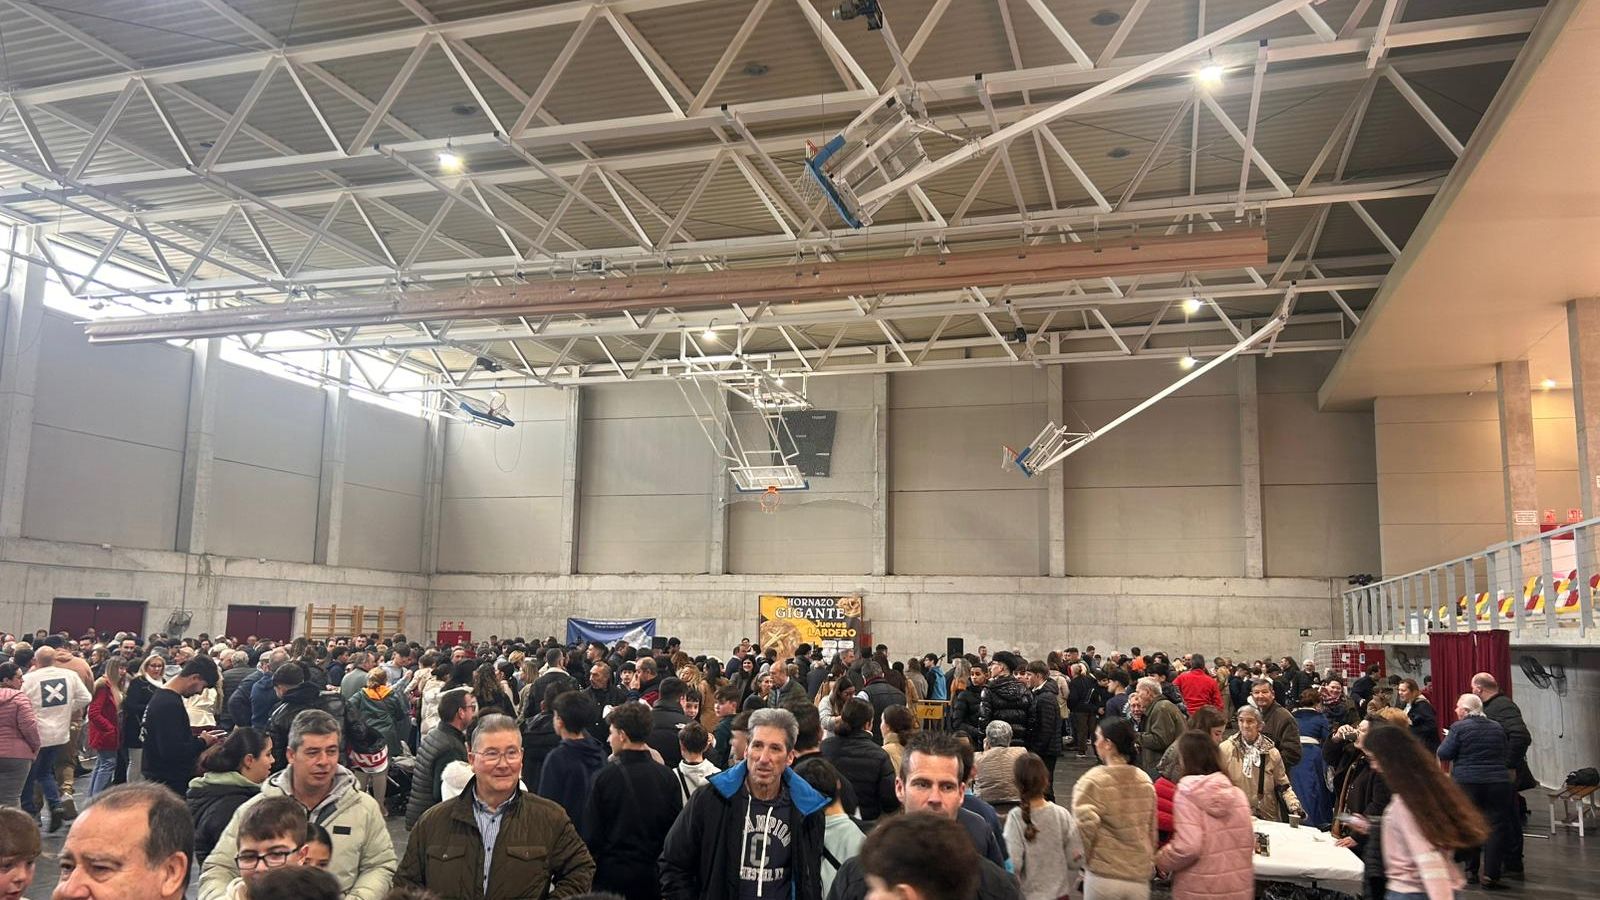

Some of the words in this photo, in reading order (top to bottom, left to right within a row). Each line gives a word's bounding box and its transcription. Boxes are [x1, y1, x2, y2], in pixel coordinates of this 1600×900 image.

[787, 597, 834, 607] HORNAZO
[775, 607, 845, 620] GIGANTE
[815, 619, 847, 629] Jueves
[807, 628, 857, 638] LARDERO
[743, 814, 792, 848] AMPION
[749, 833, 772, 867] C
